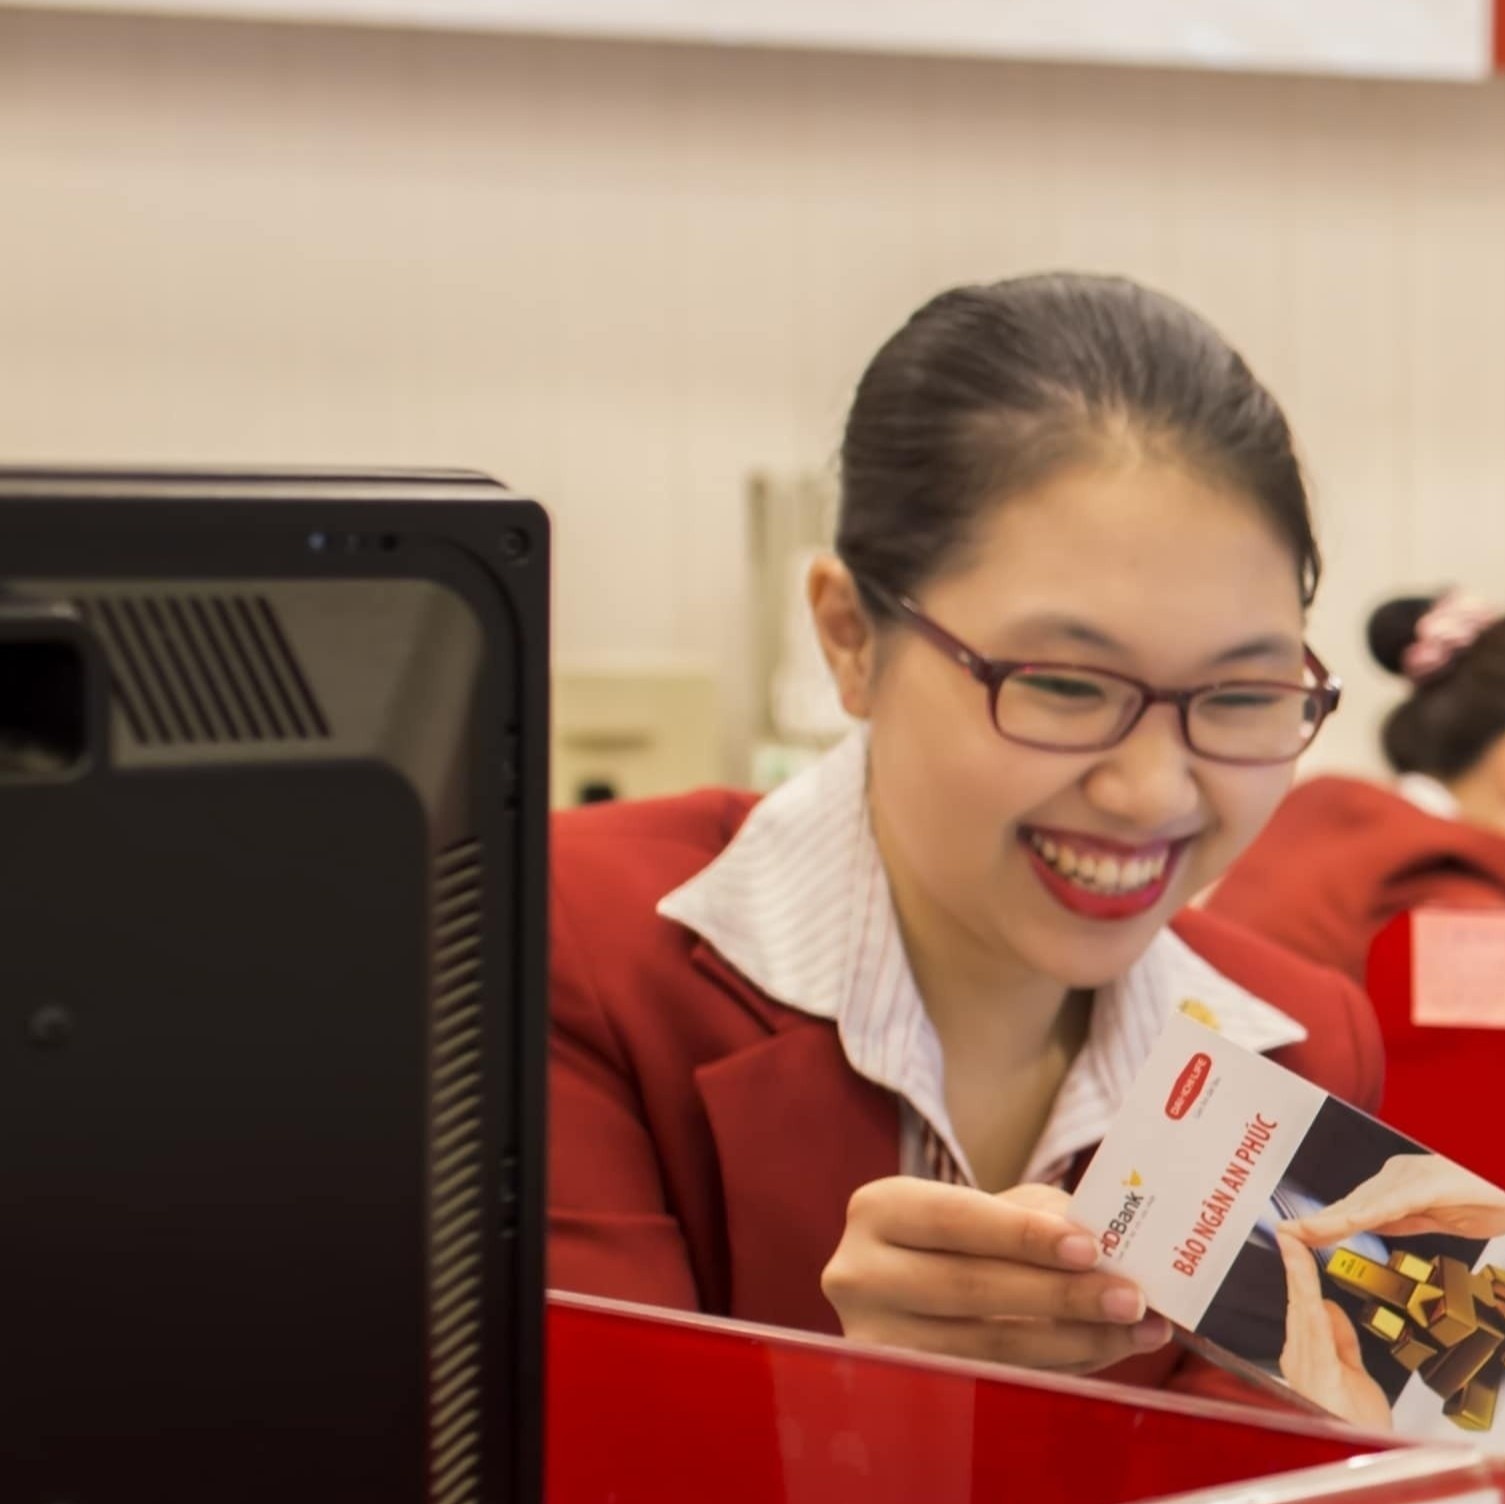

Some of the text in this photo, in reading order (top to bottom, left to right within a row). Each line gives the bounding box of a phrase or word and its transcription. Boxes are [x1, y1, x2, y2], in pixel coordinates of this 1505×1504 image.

[1100, 1191, 1144, 1257] HDBank
[1172, 1112, 1278, 1277] BẢO NGÂN AN PHÚC
